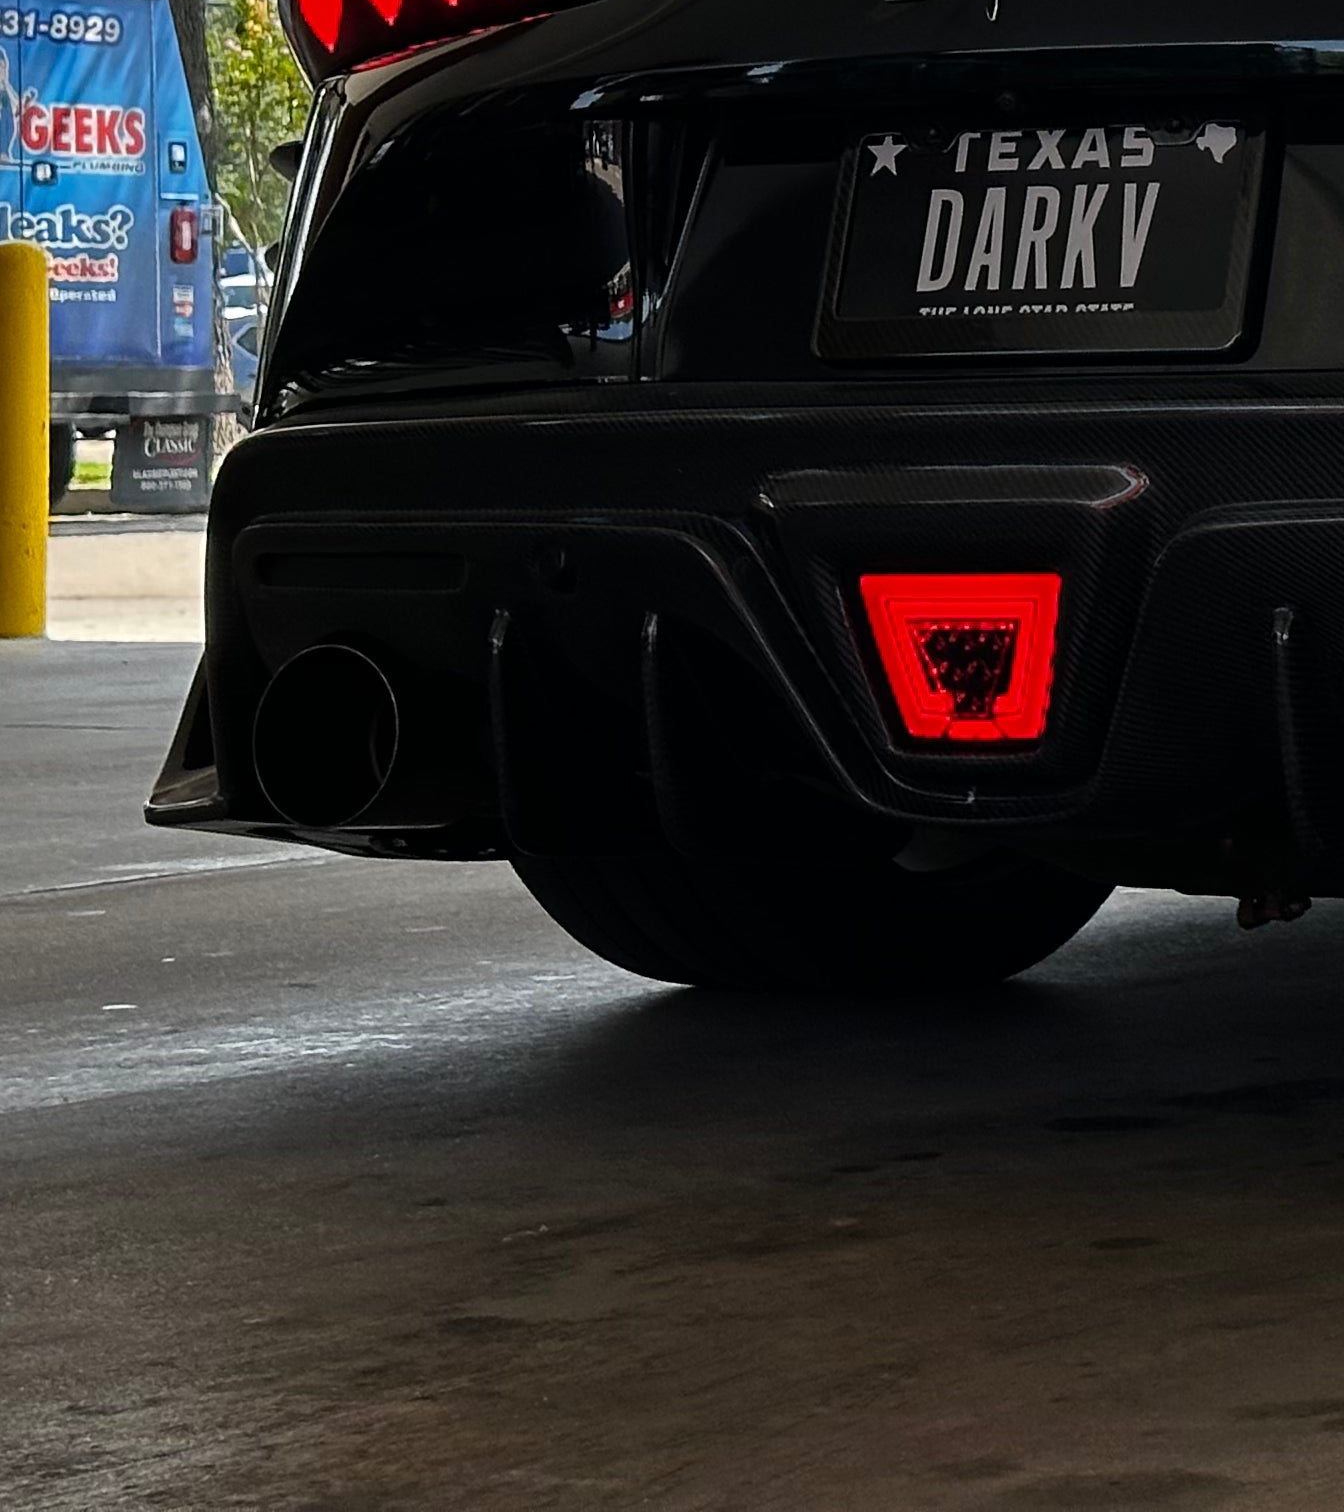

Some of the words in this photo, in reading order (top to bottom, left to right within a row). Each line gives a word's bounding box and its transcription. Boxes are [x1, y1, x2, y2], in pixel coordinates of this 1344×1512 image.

[0, 9, 121, 43] 31-8929
[21, 104, 145, 157] GEEKS
[954, 126, 1156, 173] TEXAS
[915, 182, 1161, 293] DARKV
[48, 256, 117, 278] eeks!
[144, 438, 197, 458] CLASSIC
